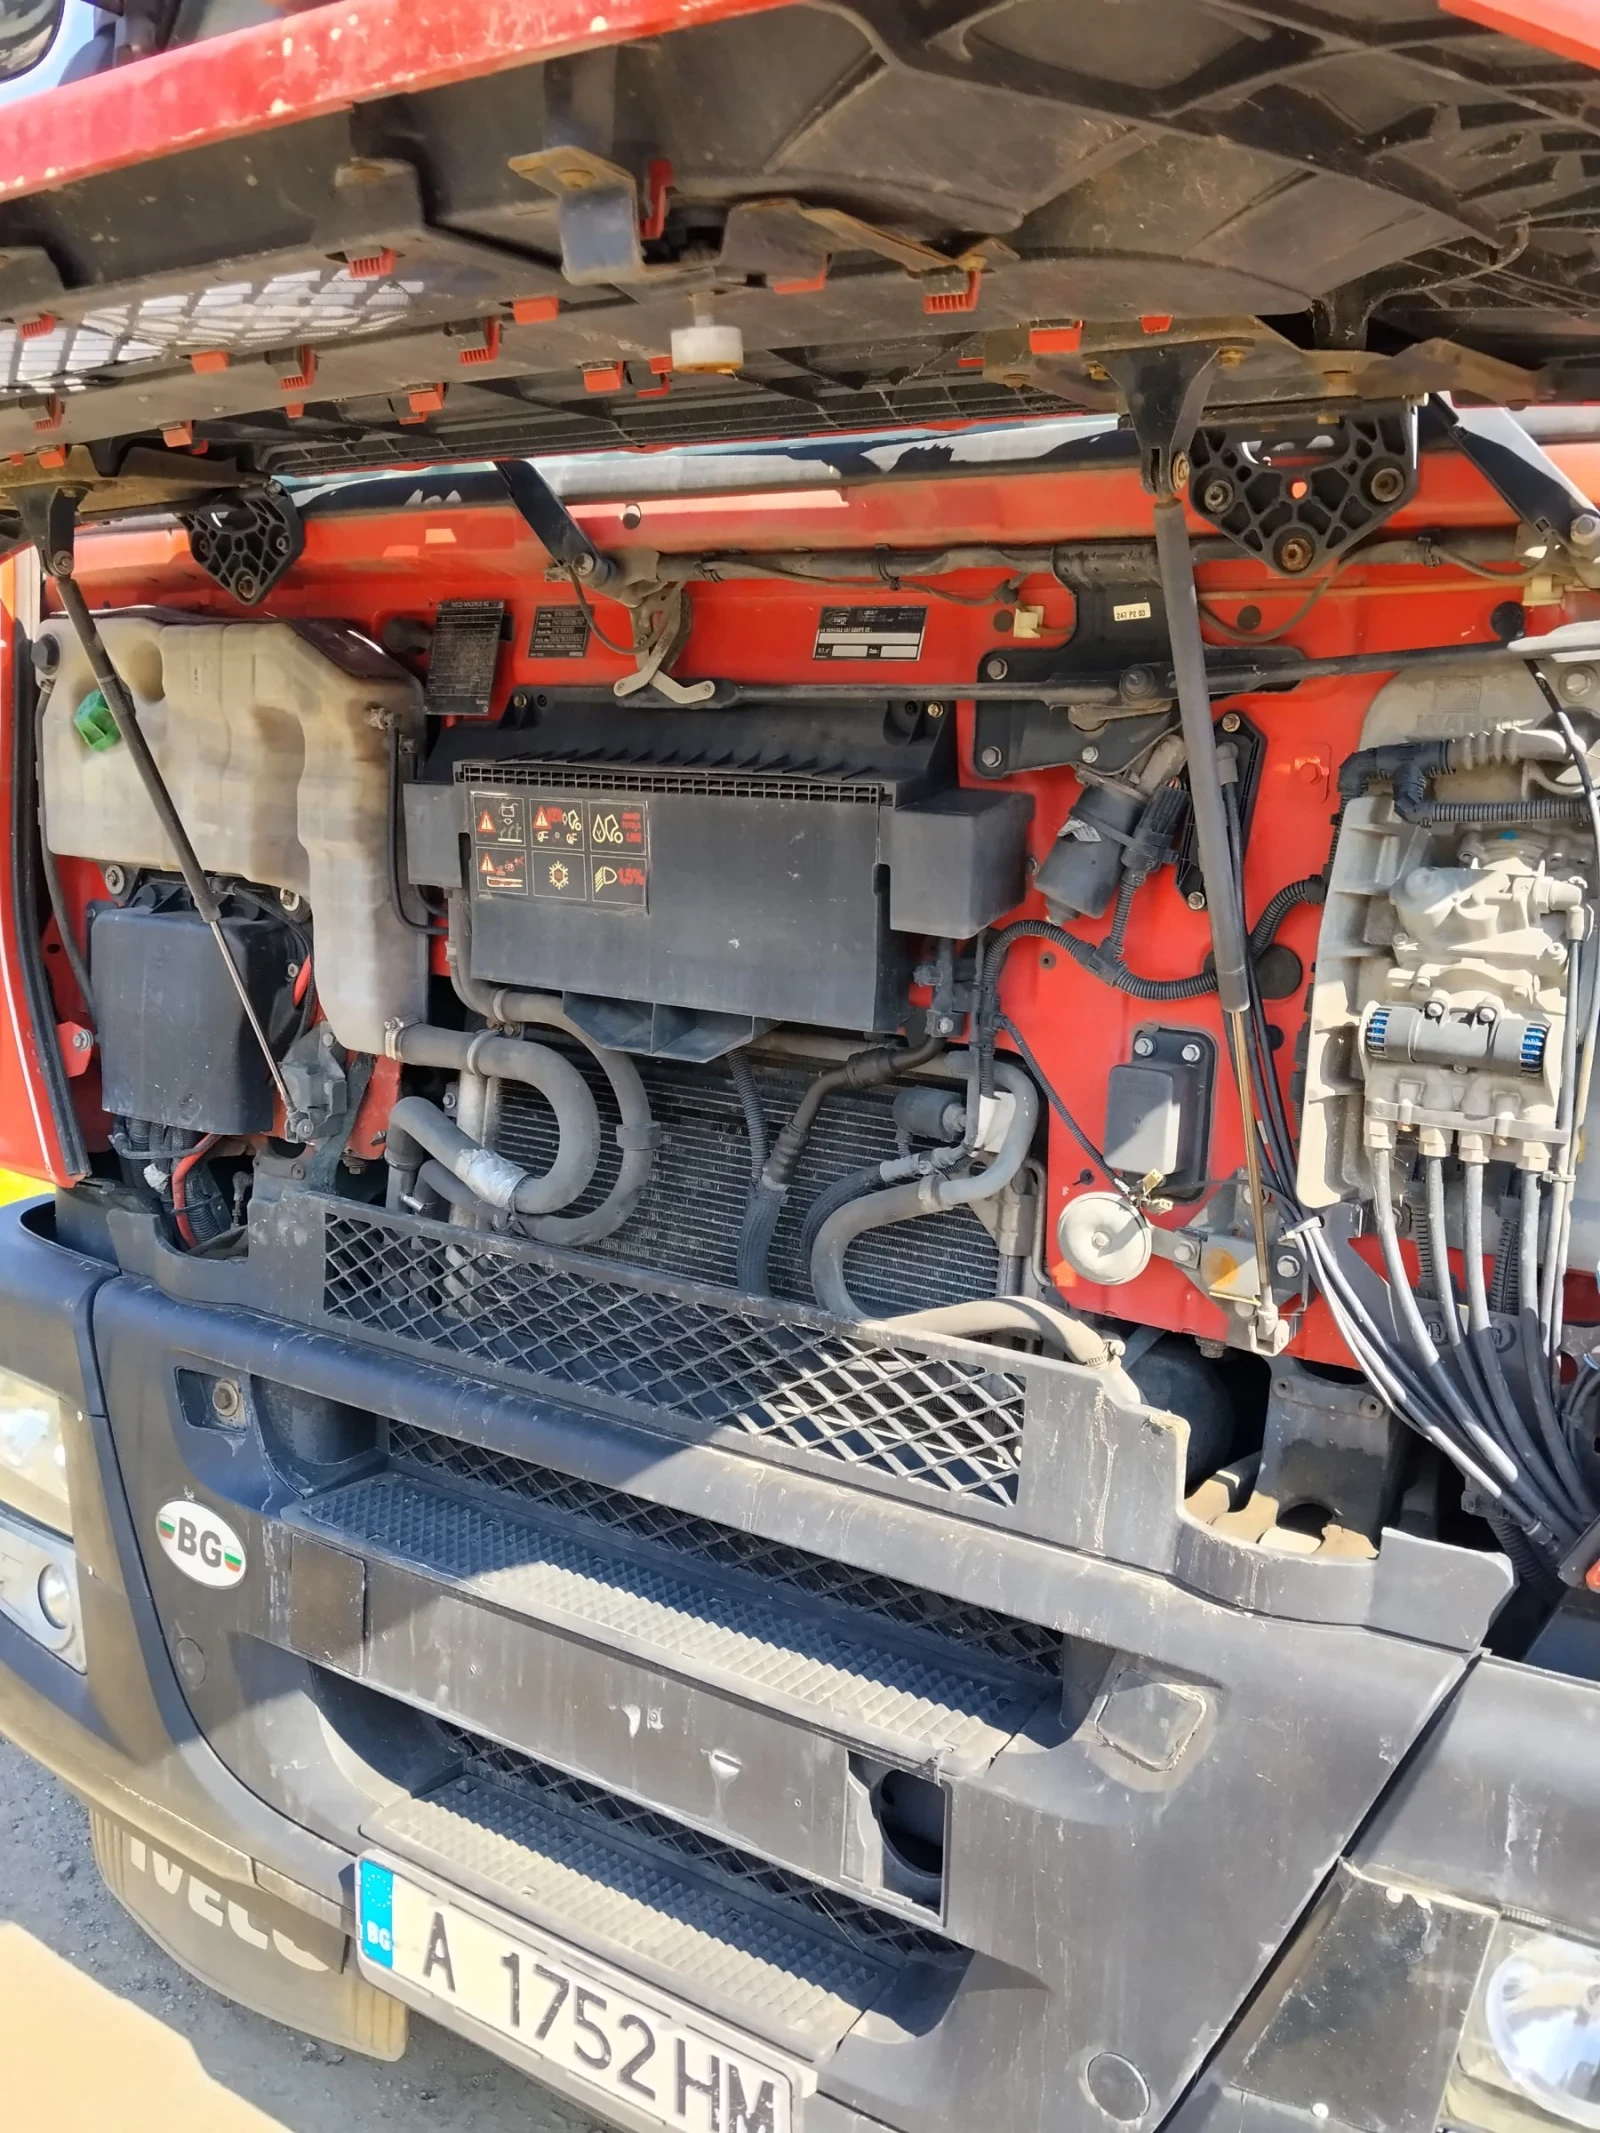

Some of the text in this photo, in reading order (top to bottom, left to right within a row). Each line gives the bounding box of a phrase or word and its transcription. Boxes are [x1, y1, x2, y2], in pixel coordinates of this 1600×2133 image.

[177, 1516, 222, 1568] BG
[366, 1919, 392, 1951] BG
[422, 1911, 456, 1993] A
[501, 1951, 657, 2101] 1752
